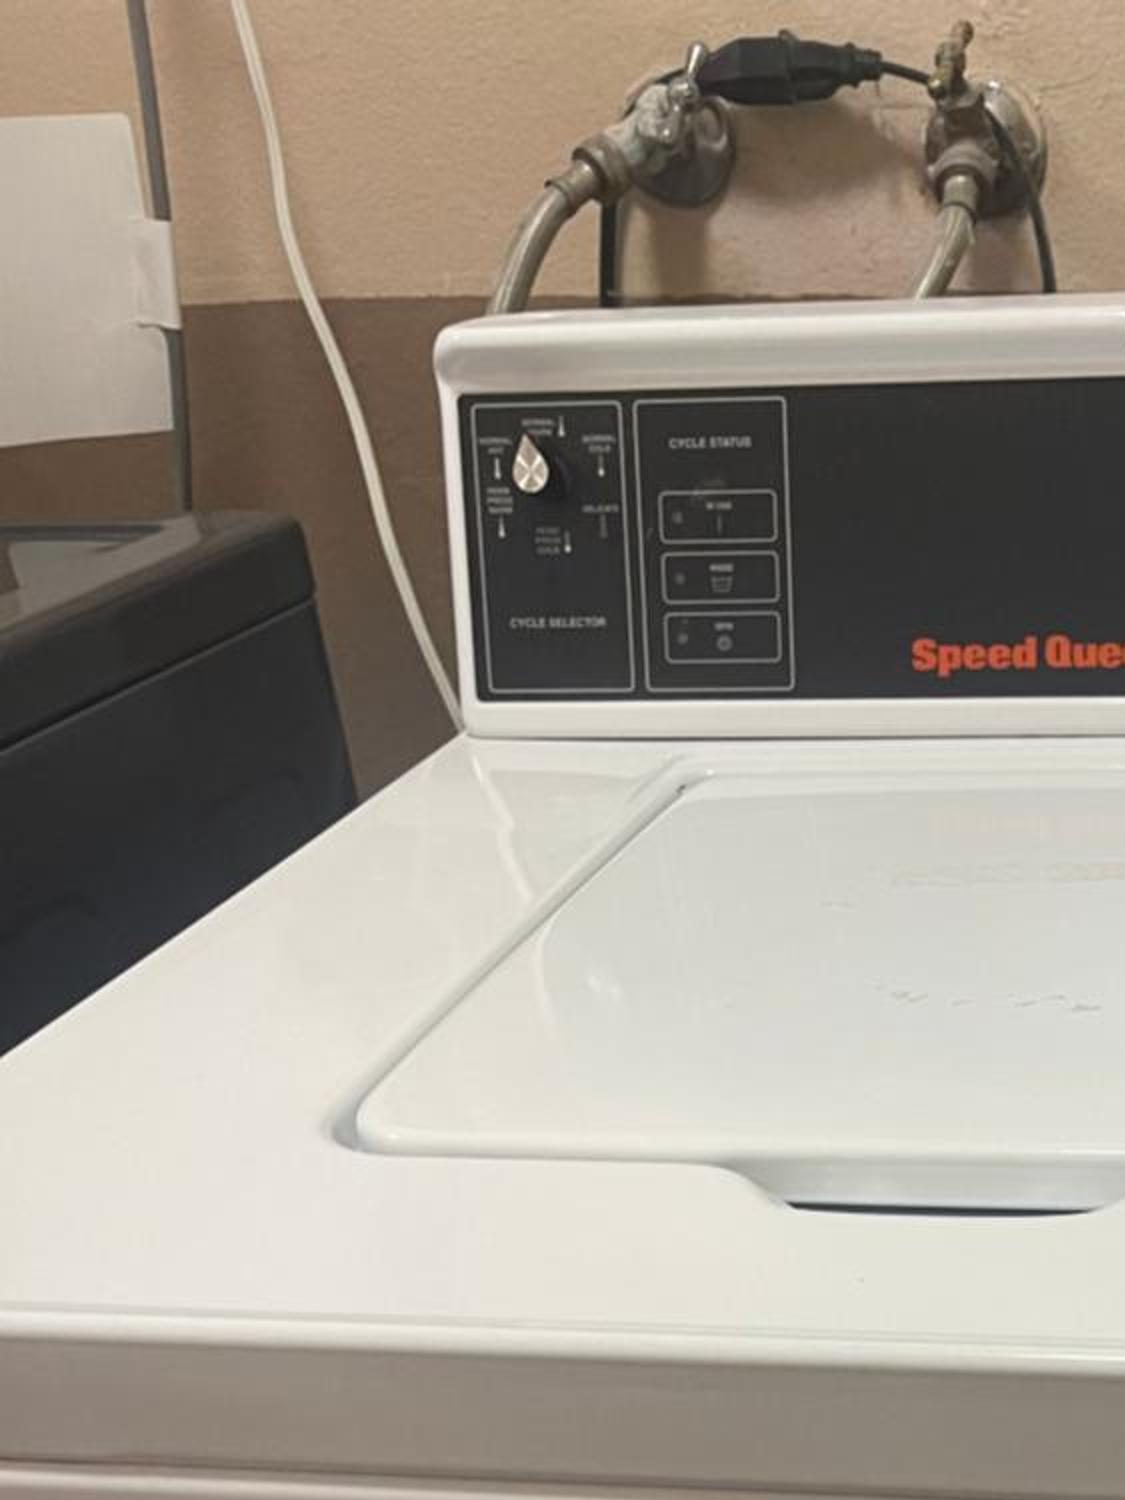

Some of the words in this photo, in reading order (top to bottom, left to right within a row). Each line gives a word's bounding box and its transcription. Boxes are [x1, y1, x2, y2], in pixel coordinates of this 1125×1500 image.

[668, 437, 706, 449] CYCLE
[710, 436, 752, 448] STATUS
[510, 616, 545, 628] CYCLE
[550, 615, 606, 628] SELECTOR
[911, 636, 1038, 676] Speed
